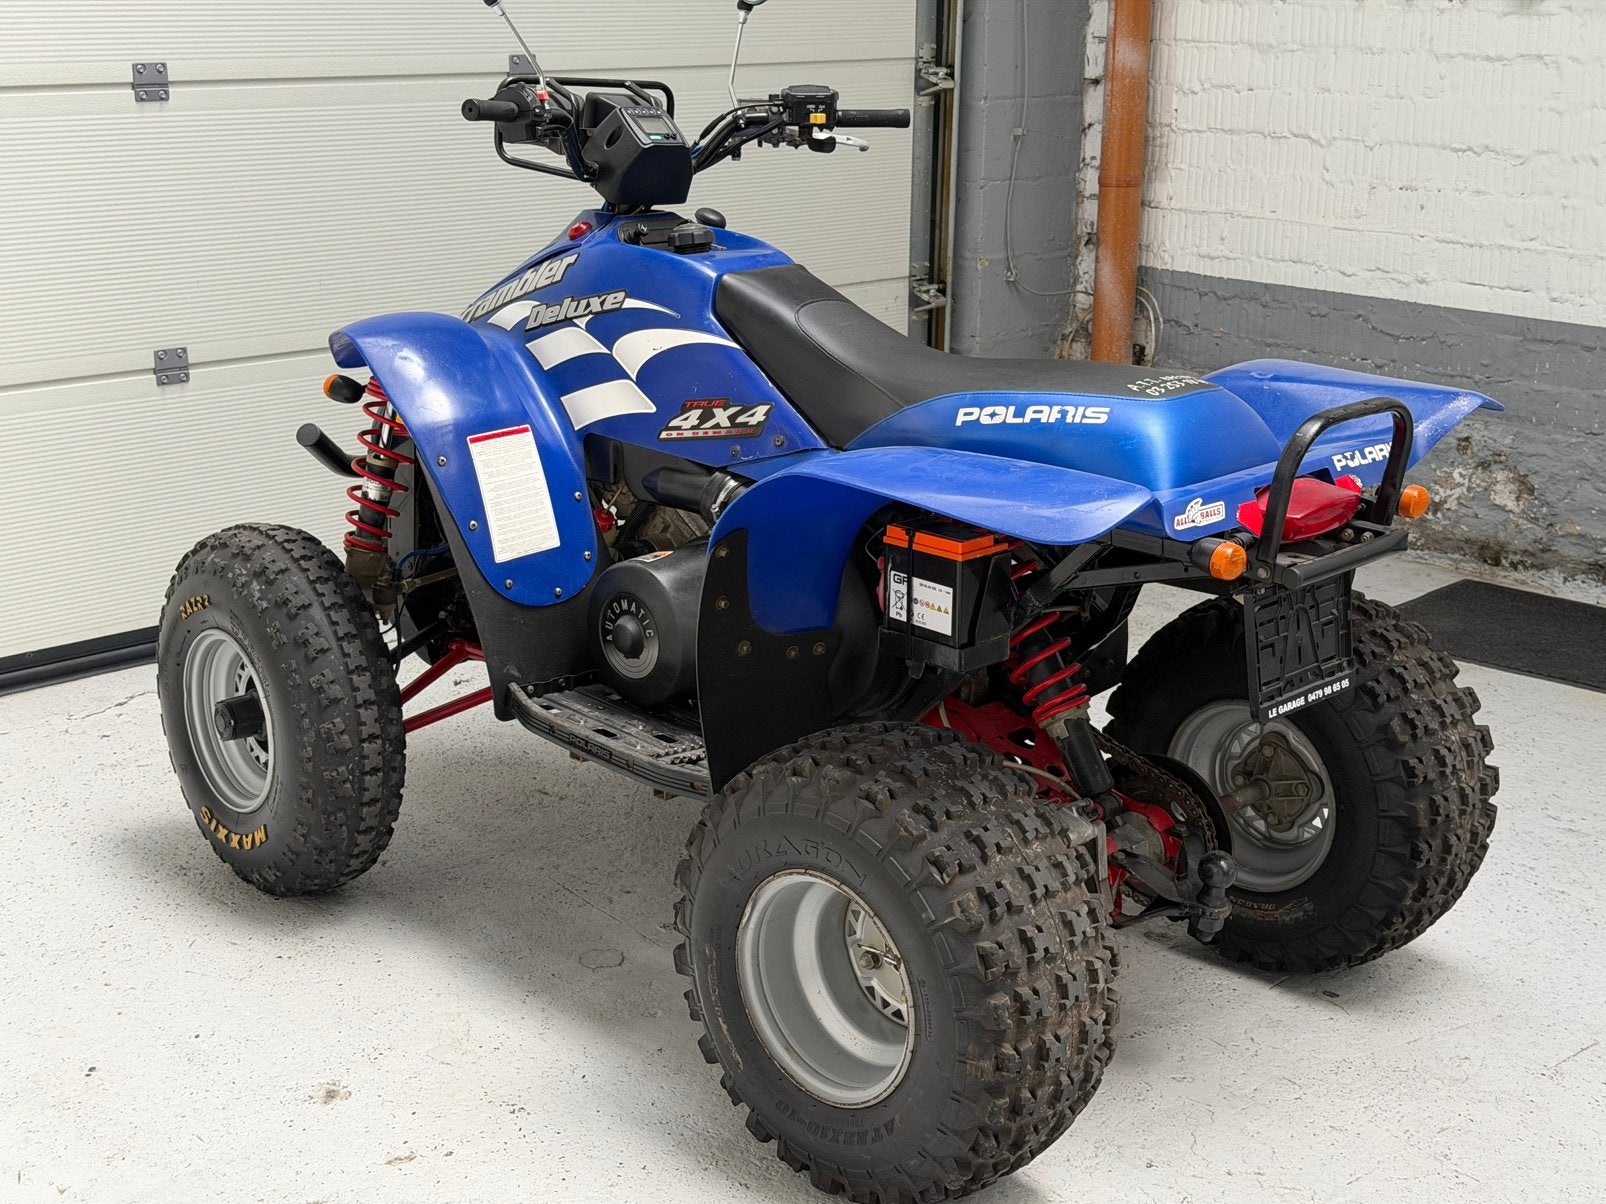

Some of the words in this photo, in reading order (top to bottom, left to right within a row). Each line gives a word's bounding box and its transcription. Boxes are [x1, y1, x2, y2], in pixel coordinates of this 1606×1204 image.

[525, 290, 627, 330] Deluxe
[684, 399, 727, 408] TRUE
[955, 404, 1111, 427] POLARIS
[1200, 507, 1221, 520] BALLS
[605, 598, 654, 642] AUTOMATIC
[1268, 708, 1277, 718] LE
[1278, 696, 1306, 714] GARAGE
[1308, 690, 1323, 702] 0479
[1341, 679, 1349, 688] 05
[569, 734, 609, 757] POLARIS
[199, 806, 267, 851] MAXXIS
